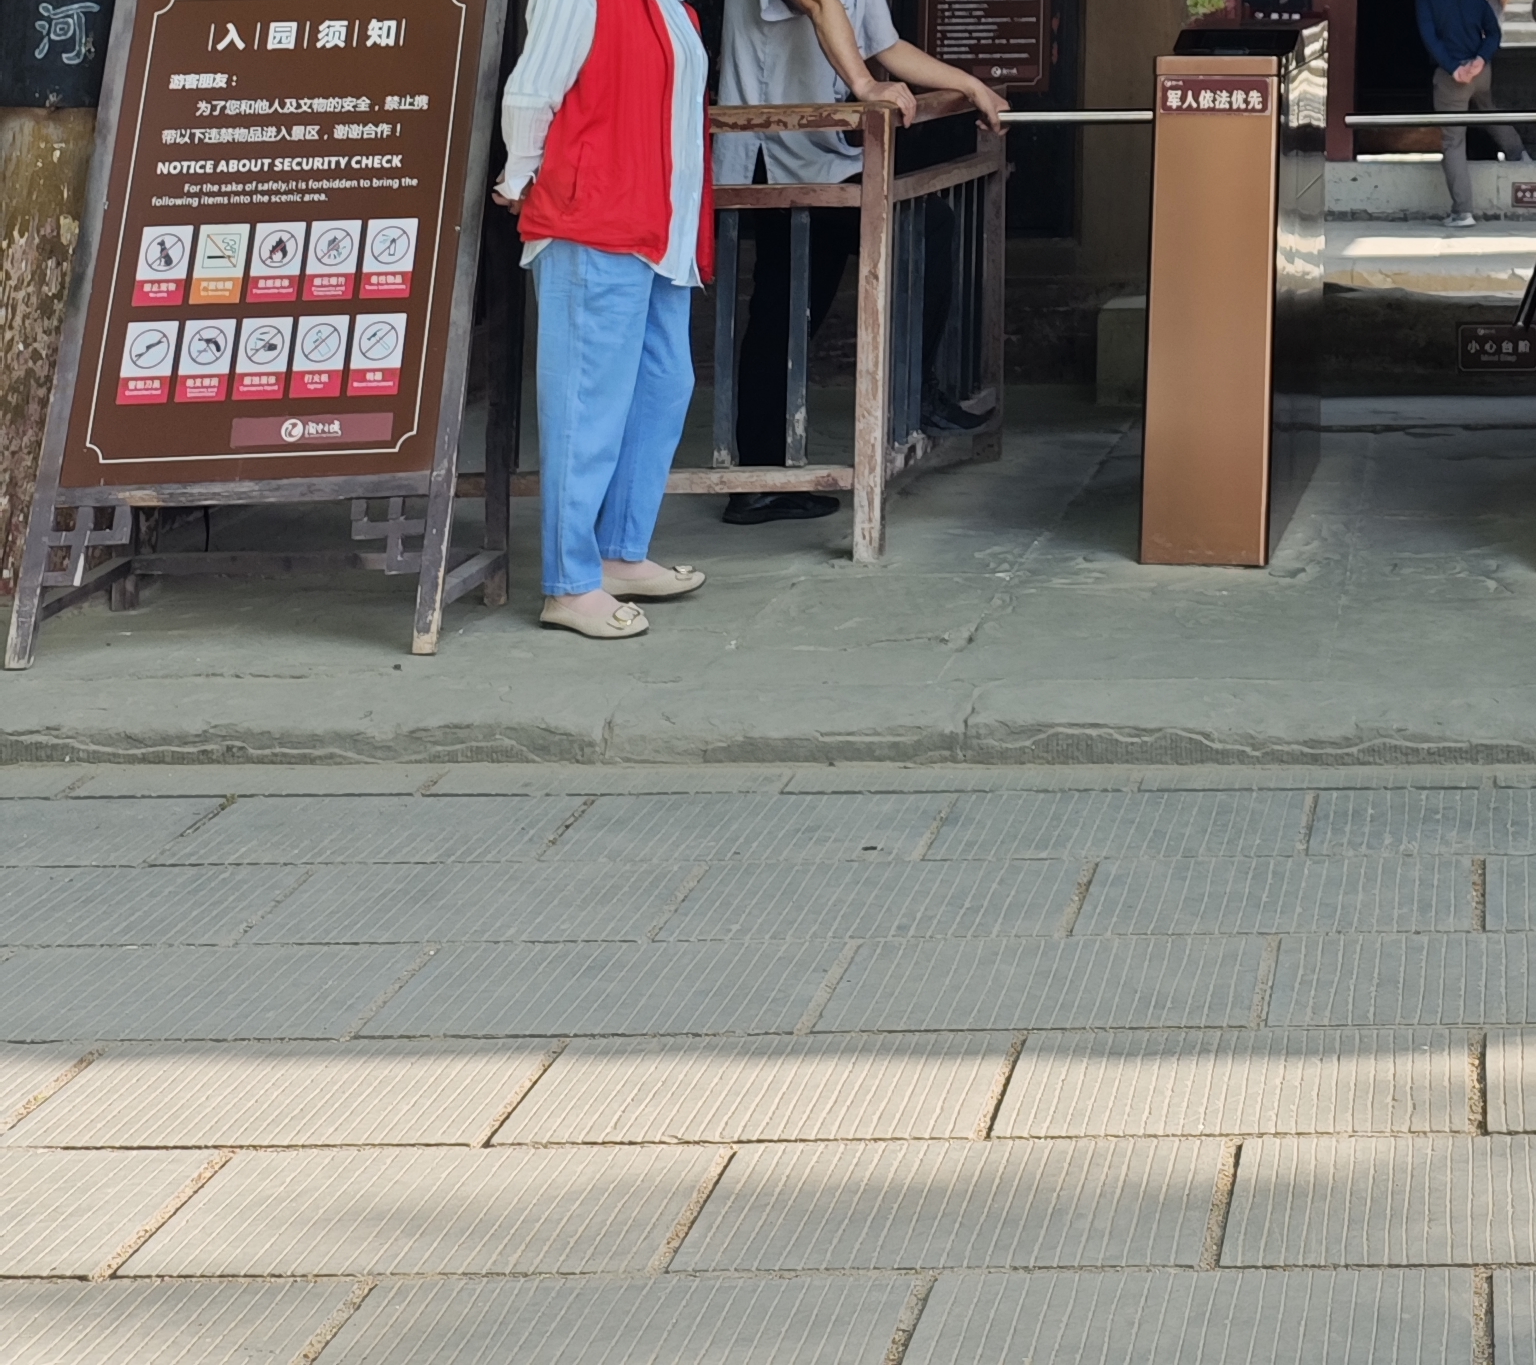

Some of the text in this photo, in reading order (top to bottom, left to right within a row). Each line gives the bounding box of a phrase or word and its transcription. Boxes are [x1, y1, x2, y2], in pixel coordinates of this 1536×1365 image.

[215, 18, 398, 52] 入园须知
[1166, 89, 1264, 110] 军人依法优先
[155, 154, 404, 176] NOTICE ABOUT SECURITY CHECK
[184, 182, 202, 194] For
[202, 182, 220, 193] the
[220, 181, 244, 193] sake
[244, 180, 258, 192] of
[297, 179, 307, 190] is
[307, 177, 359, 190] forbidden
[359, 178, 371, 189] to
[371, 177, 400, 190] bring
[400, 176, 419, 188] the
[151, 195, 200, 208] following
[200, 194, 230, 205] items
[229, 194, 252, 205] into
[251, 193, 270, 204] the
[269, 192, 303, 204] scenic
[1466, 339, 1532, 355] 小心台阶
